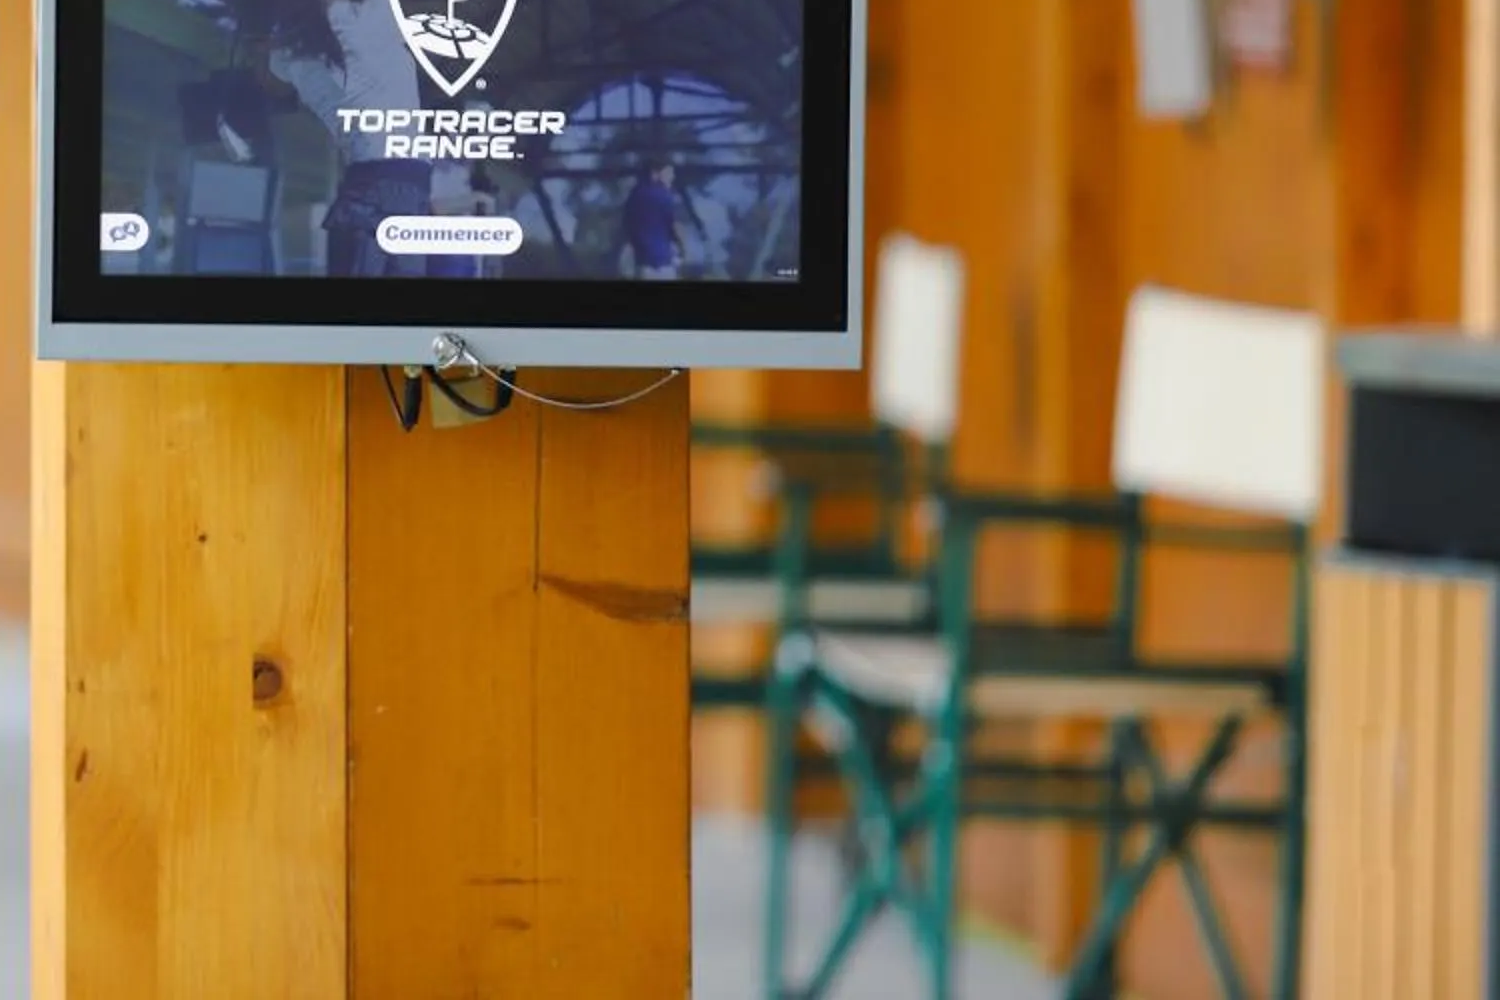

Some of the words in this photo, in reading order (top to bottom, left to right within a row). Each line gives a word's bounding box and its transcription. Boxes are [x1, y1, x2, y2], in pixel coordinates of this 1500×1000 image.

[337, 108, 565, 135] TOPTRACER
[385, 134, 516, 159] RANGE
[385, 224, 514, 242] Commencer
